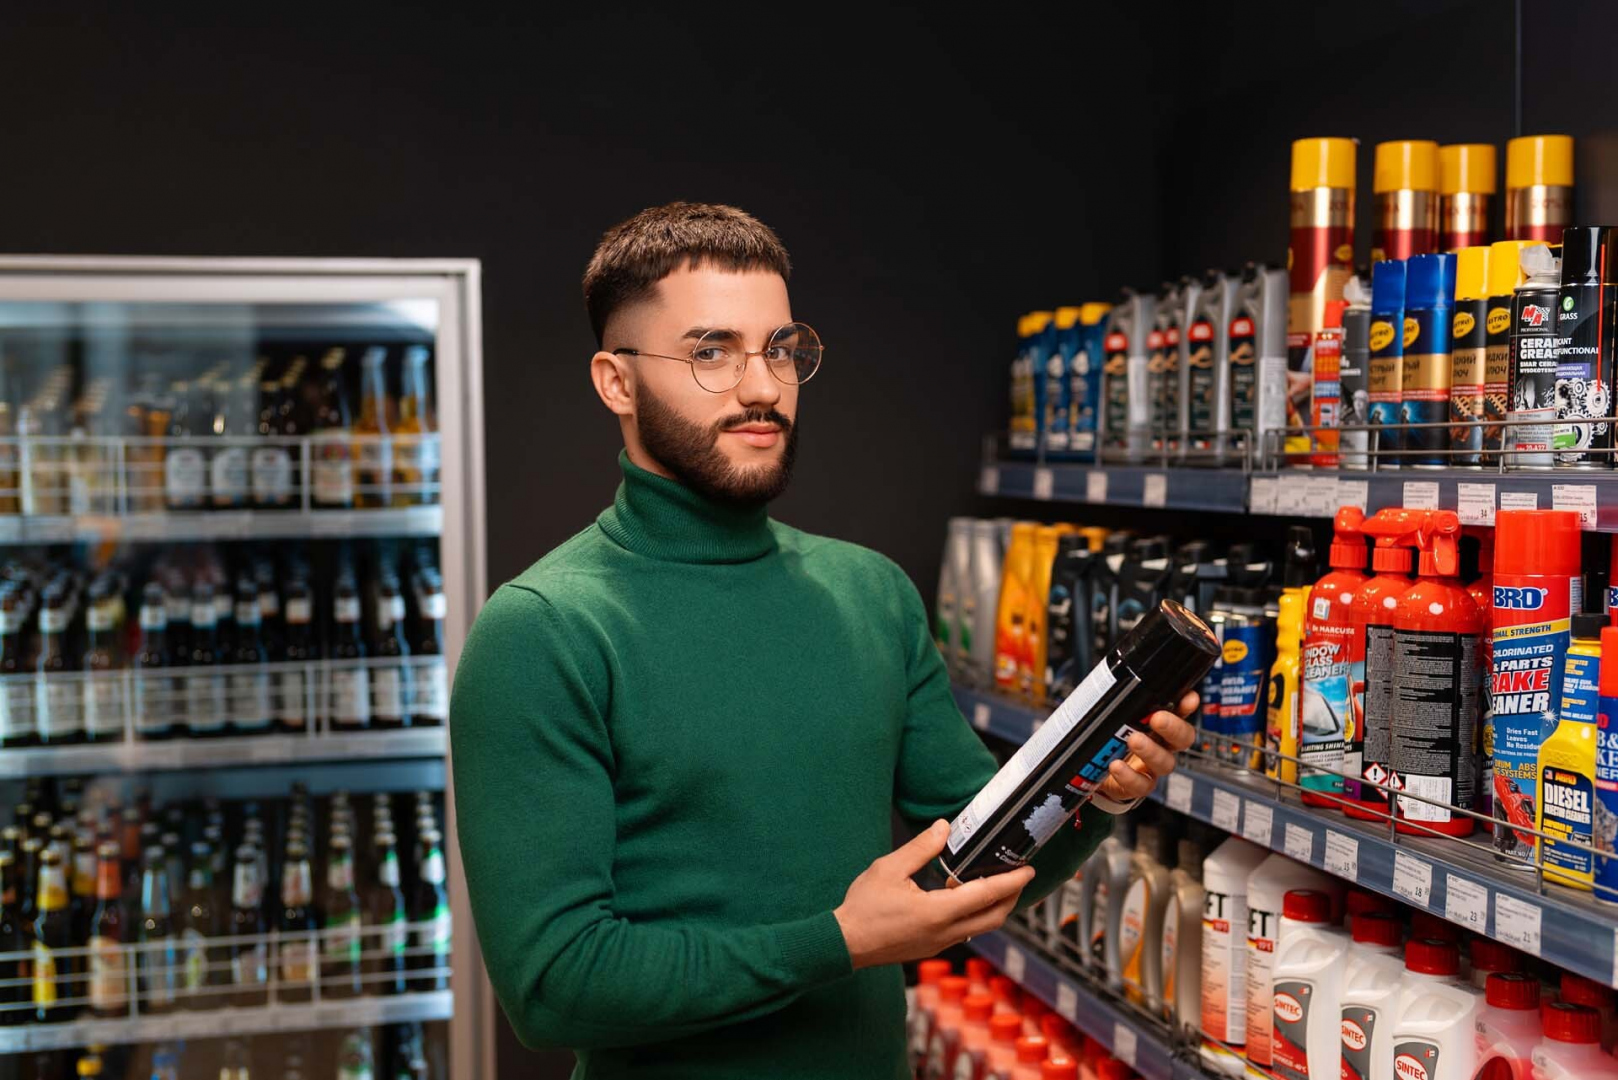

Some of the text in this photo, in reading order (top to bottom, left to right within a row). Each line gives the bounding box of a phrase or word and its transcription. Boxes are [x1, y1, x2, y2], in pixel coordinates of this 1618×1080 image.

[1510, 624, 1551, 636] STRENGTH
[1500, 656, 1553, 671] PARTS
[1500, 769, 1538, 780] SYSTEMS
[1518, 763, 1537, 772] ABS
[1544, 782, 1590, 813] DIESEL
[1274, 998, 1300, 1017] SINTEC
[1396, 1060, 1425, 1080] SINTEC
